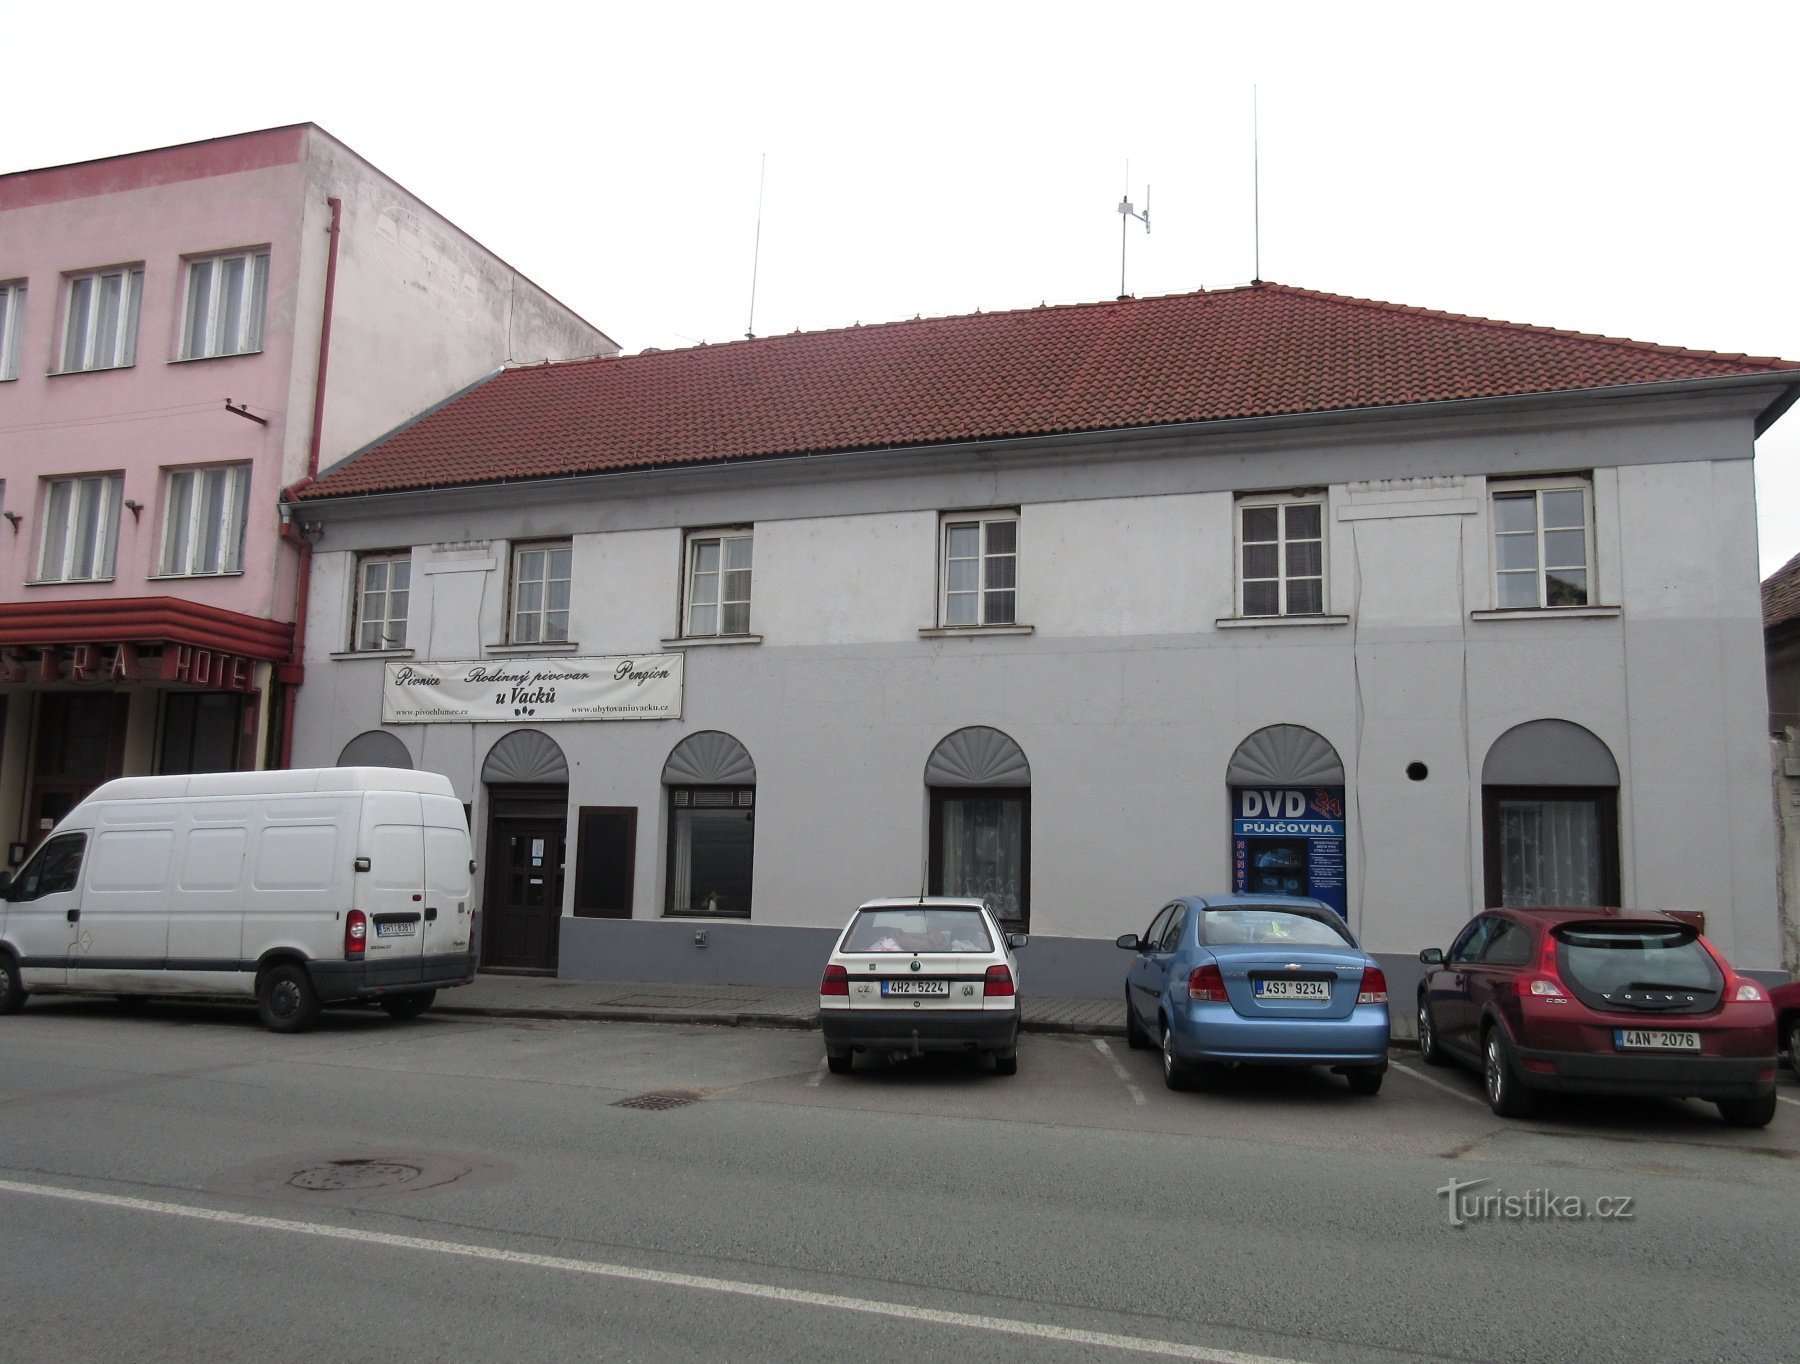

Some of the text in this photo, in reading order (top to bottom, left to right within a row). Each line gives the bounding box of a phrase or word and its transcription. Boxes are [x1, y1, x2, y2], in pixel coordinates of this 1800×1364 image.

[174, 644, 263, 691] HOTEL
[395, 666, 441, 686] Pivnice
[613, 660, 670, 687] Penzion
[464, 666, 590, 688] Rodinný pivovar
[495, 686, 556, 705] u Vacků
[395, 707, 469, 718] www.pivochlumec.cz
[571, 703, 669, 714] www.ubytovaniuvacku.cz
[1242, 790, 1306, 818] DVD
[1314, 788, 1342, 818] 24
[1243, 821, 1335, 834] PŮJČOVNA
[890, 981, 944, 993] 4H2 5224
[1266, 983, 1323, 995] 4S3 9234
[1602, 993, 1694, 1001] VOLVO
[1626, 1031, 1695, 1047] 4AN 2076
